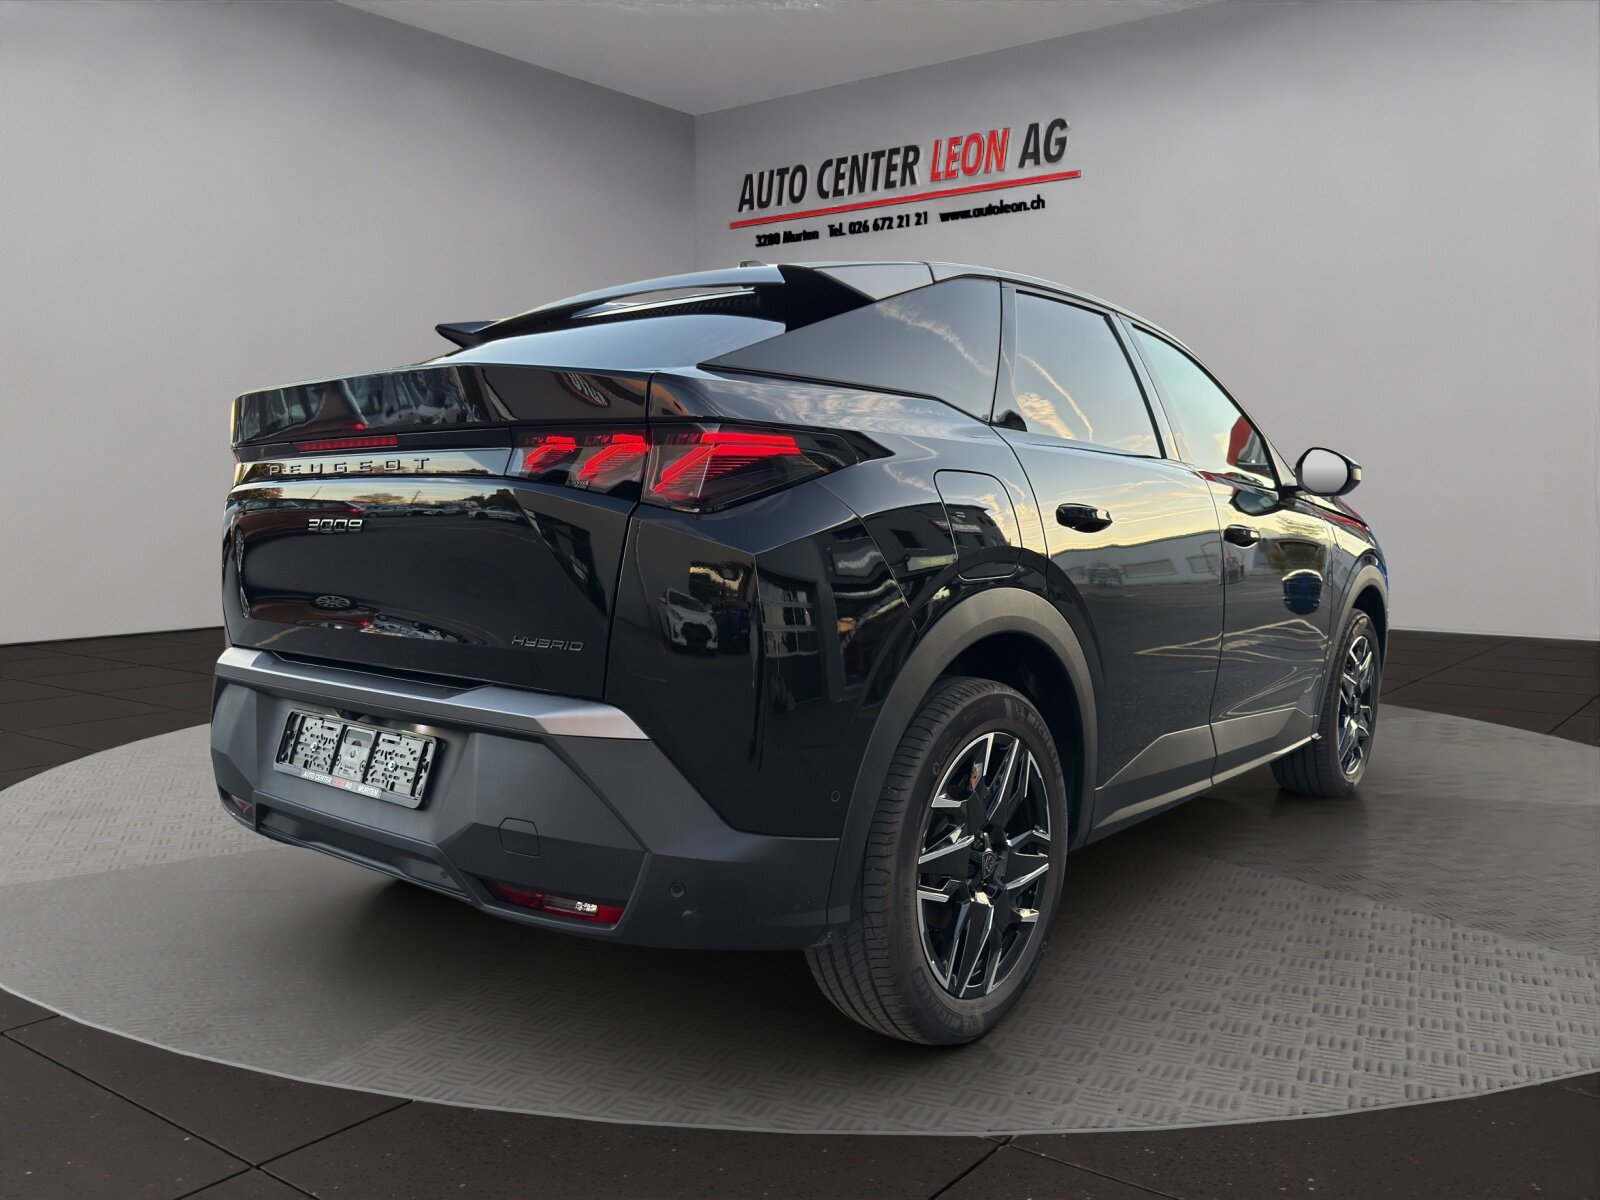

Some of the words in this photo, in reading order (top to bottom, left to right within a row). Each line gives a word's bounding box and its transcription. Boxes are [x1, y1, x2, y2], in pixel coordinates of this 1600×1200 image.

[738, 164, 807, 212] AUTO
[817, 145, 920, 199] CENTER
[930, 128, 1010, 182] LEON
[1018, 118, 1069, 168] AG
[783, 230, 819, 244] Murten
[849, 220, 870, 234] 026
[873, 216, 894, 231] 672
[897, 214, 910, 228] 21
[915, 211, 928, 226] 21
[939, 194, 1046, 222] www.autoleon.ch
[268, 457, 430, 476] PEUGEOT
[307, 518, 364, 534] 3008
[511, 635, 584, 651] HYBRID
